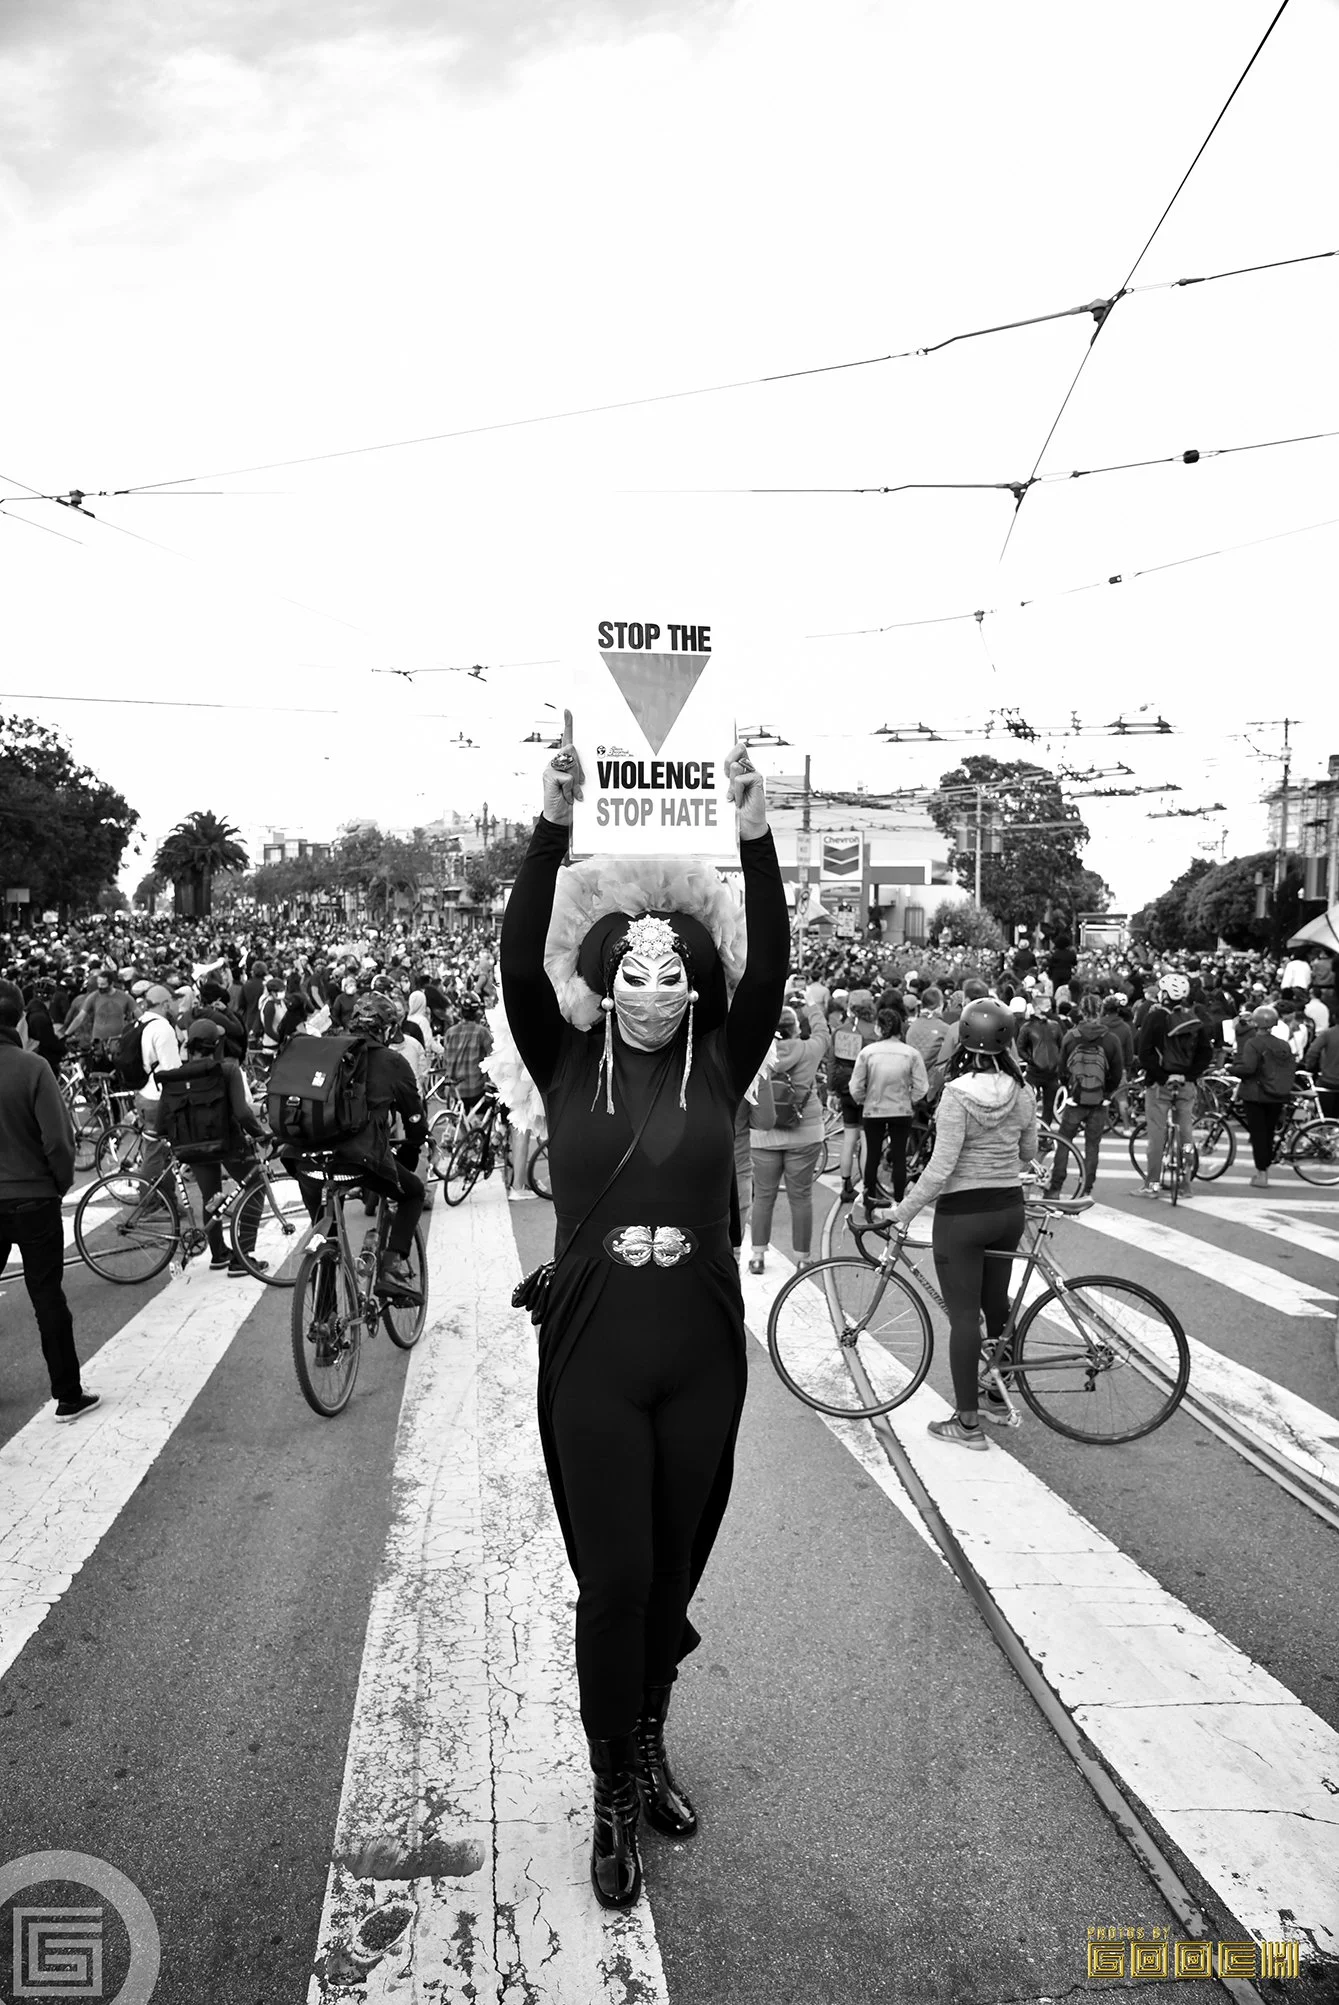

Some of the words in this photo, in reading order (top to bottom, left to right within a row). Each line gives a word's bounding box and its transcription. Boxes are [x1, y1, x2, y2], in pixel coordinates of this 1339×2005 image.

[598, 621, 661, 650] STOP
[667, 624, 712, 652] THE
[597, 761, 715, 790] VIOLENCE
[596, 797, 654, 827] STOP
[660, 798, 718, 827] HATE
[823, 835, 860, 845] Chevron
